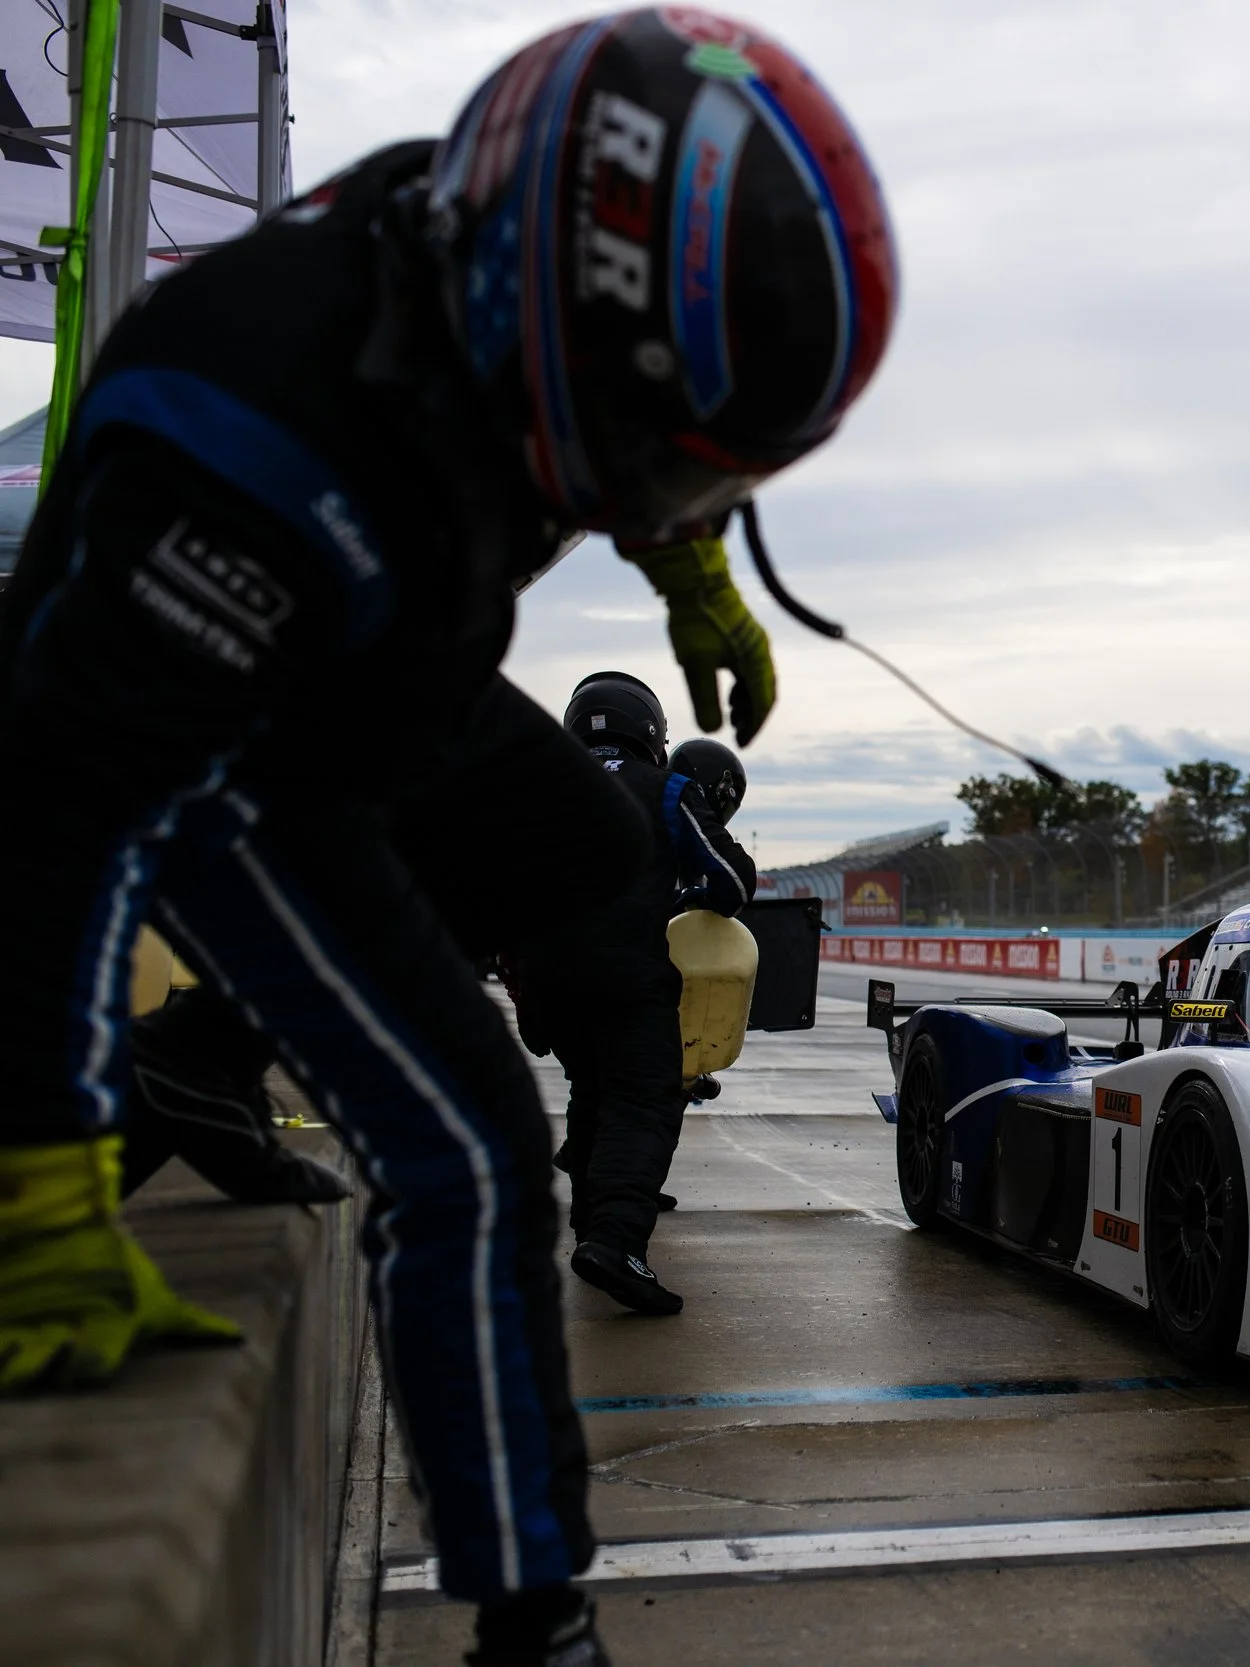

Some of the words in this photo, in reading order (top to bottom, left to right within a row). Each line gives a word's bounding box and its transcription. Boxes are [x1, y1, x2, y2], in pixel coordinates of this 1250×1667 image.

[592, 90, 666, 311] R3R
[1172, 1004, 1225, 1017] Sabelt
[1104, 1092, 1132, 1114] WRL
[1112, 1127, 1122, 1212] 1
[1103, 1217, 1131, 1242] GTU
